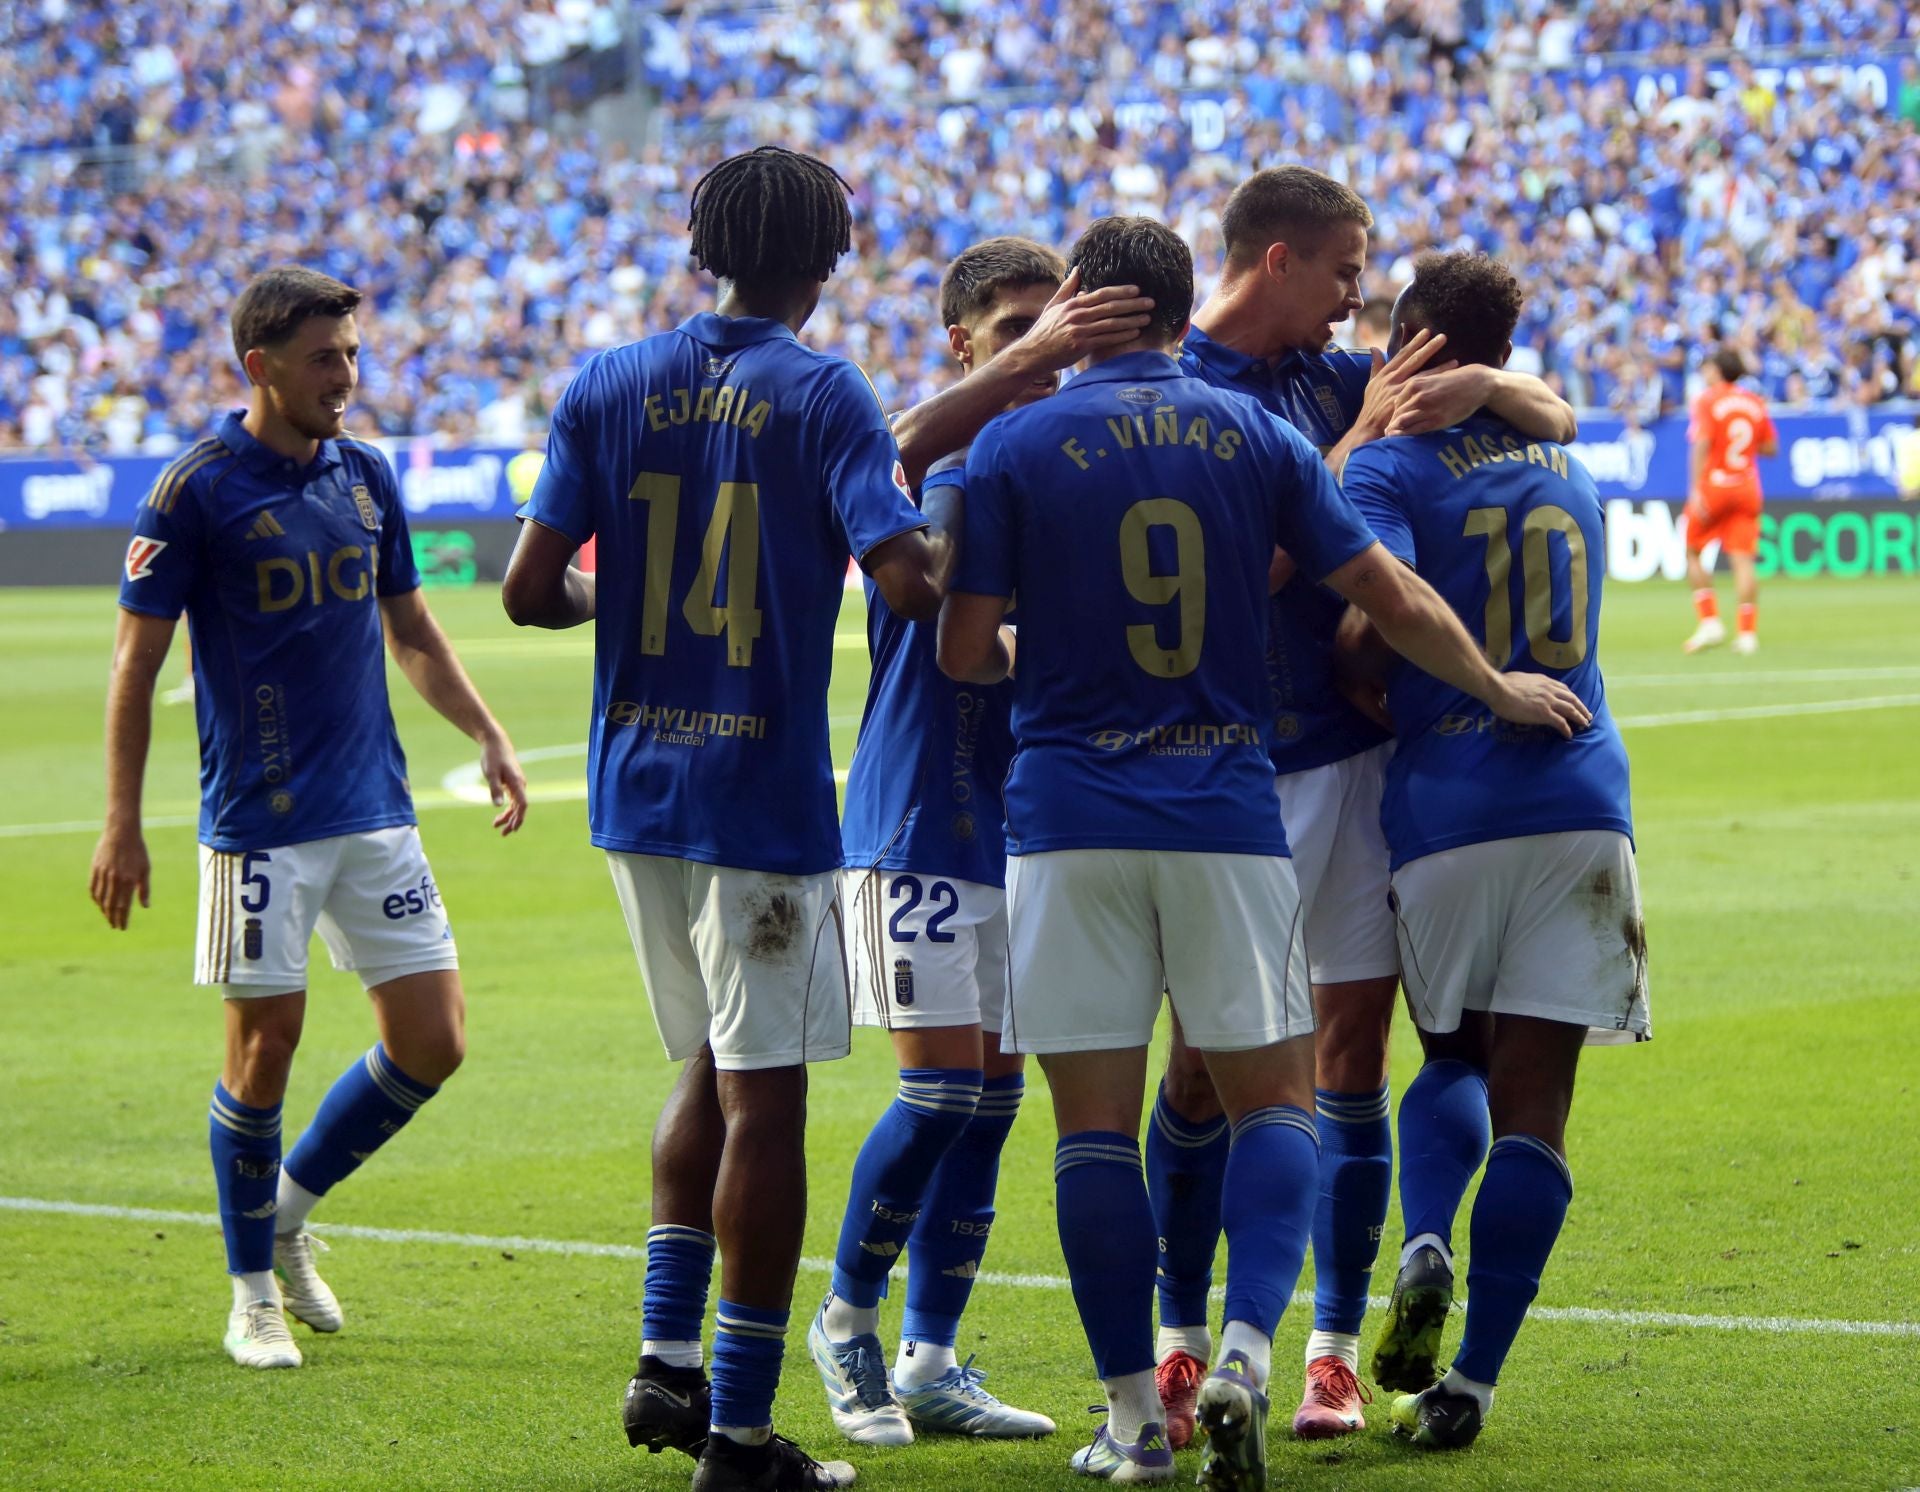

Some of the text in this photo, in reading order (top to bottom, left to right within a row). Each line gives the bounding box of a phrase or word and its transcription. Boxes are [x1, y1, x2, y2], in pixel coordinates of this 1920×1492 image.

[645, 385, 771, 439] EJARIA
[1061, 405, 1242, 470] F. VIÑAS
[1437, 434, 1568, 480] HASSAN
[1725, 418, 1753, 469] 2
[628, 471, 762, 667] 14
[1119, 498, 1206, 678] 9
[1463, 505, 1589, 670] 10
[256, 684, 282, 783] OVIEDO
[642, 704, 766, 739] HYUNDAI
[653, 729, 705, 747] Asturdai
[1134, 722, 1260, 746] HYUNDAI
[1148, 745, 1211, 757] Asturdai
[241, 852, 271, 913] 5
[888, 874, 959, 943] 22
[951, 1220, 993, 1237] 192
